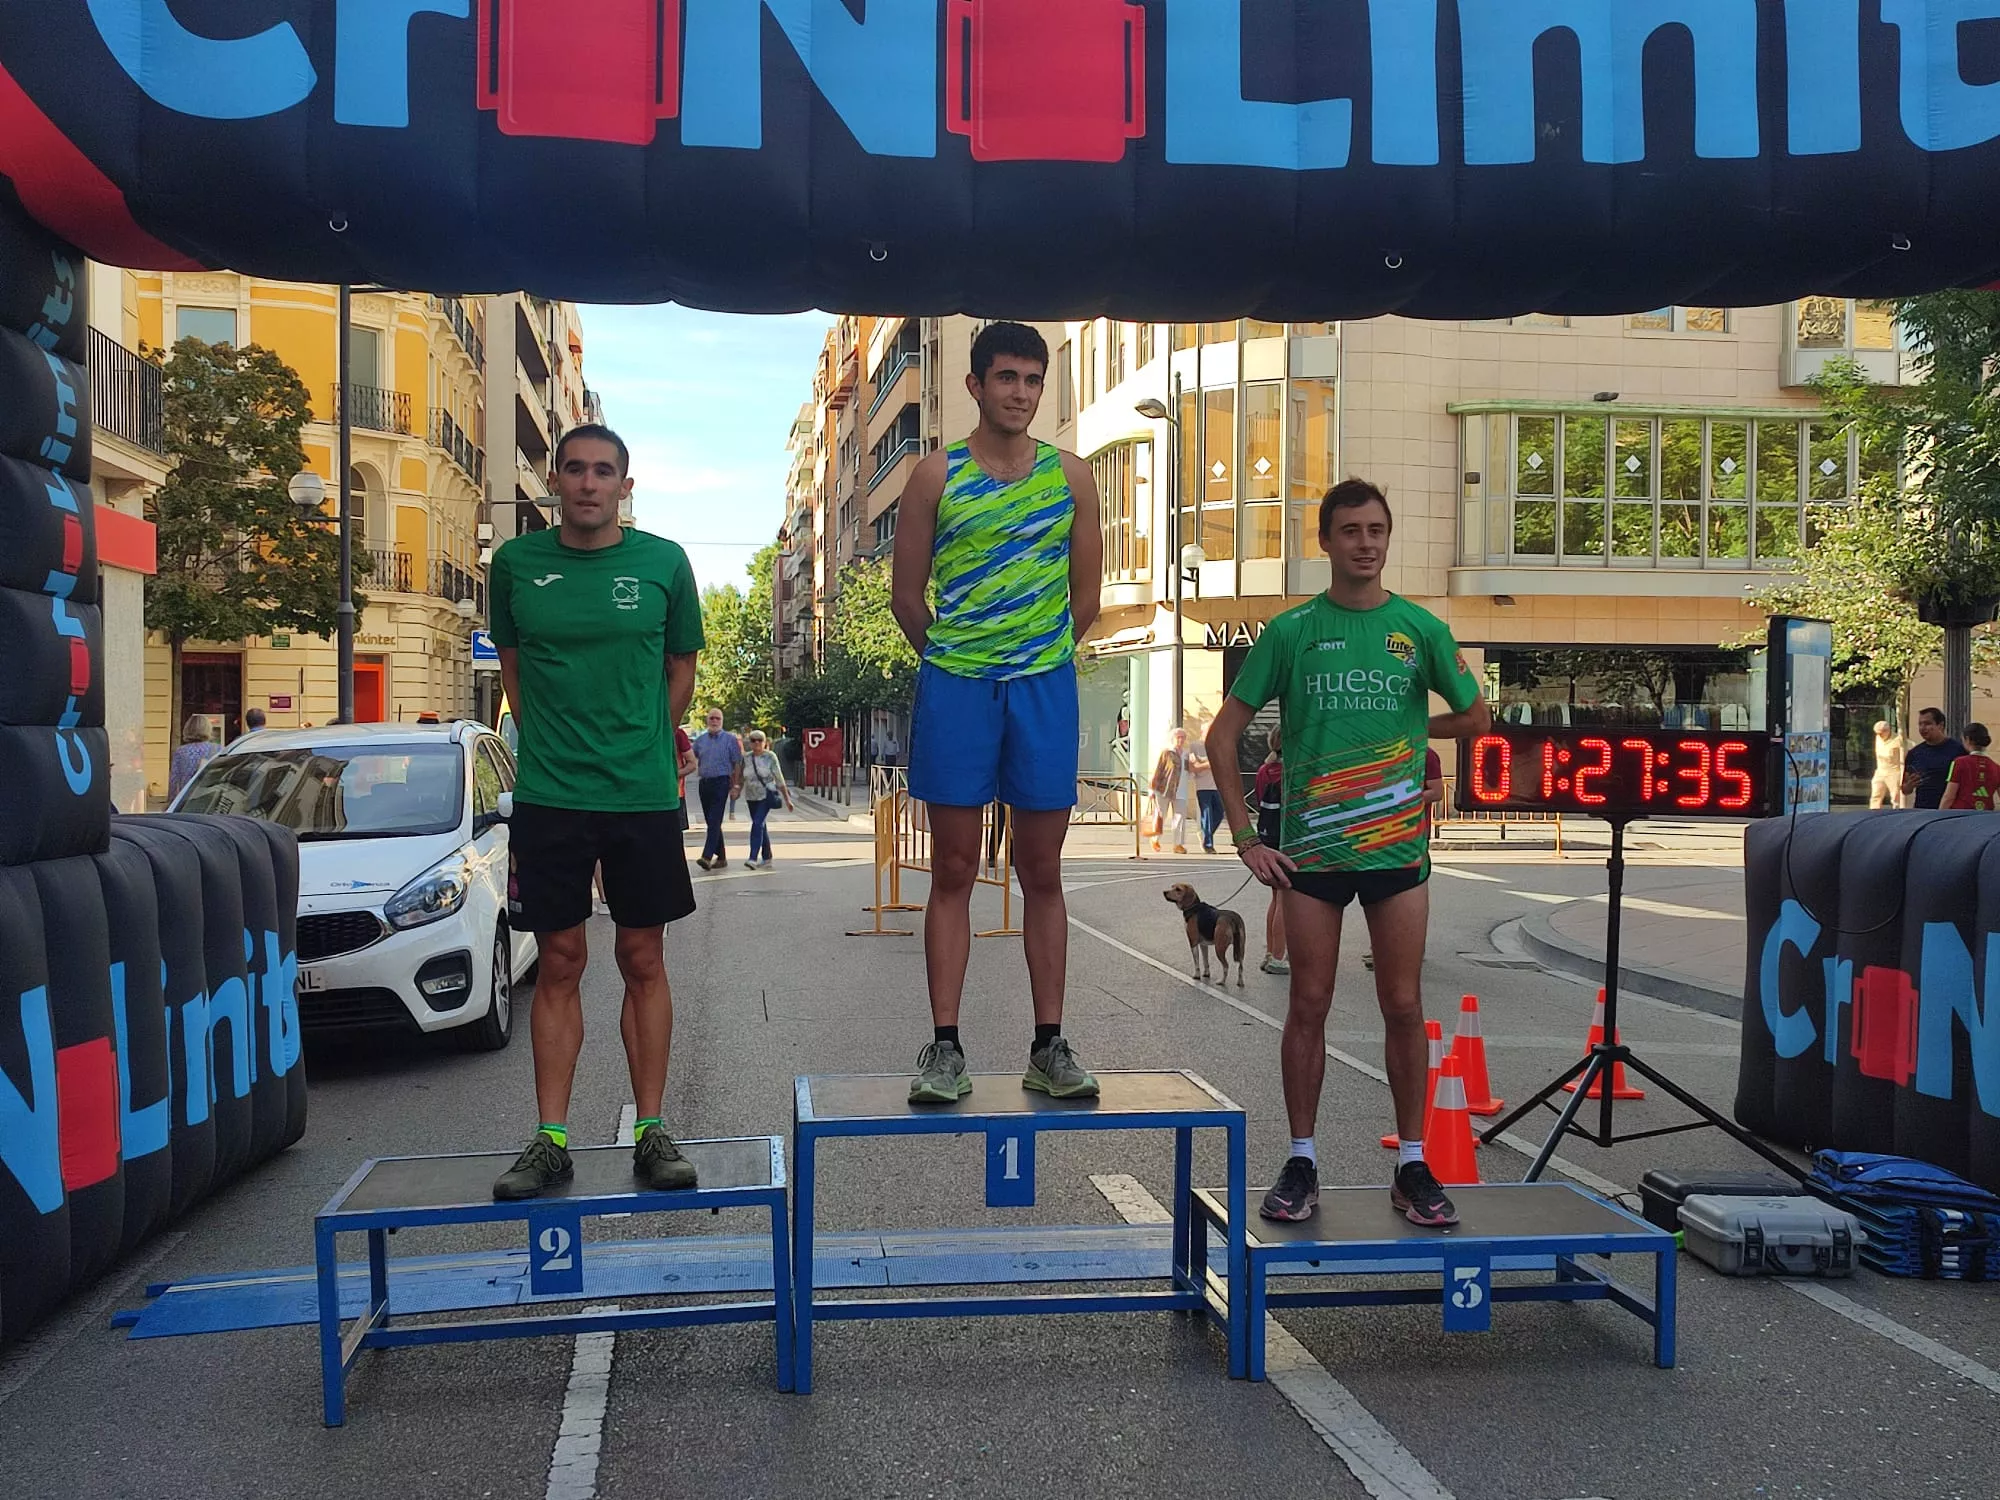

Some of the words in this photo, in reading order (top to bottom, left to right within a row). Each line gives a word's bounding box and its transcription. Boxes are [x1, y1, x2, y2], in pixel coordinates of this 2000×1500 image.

[999, 1137, 1020, 1180] 1
[539, 1227, 573, 1272] 2
[1451, 1266, 1483, 1309] 3
